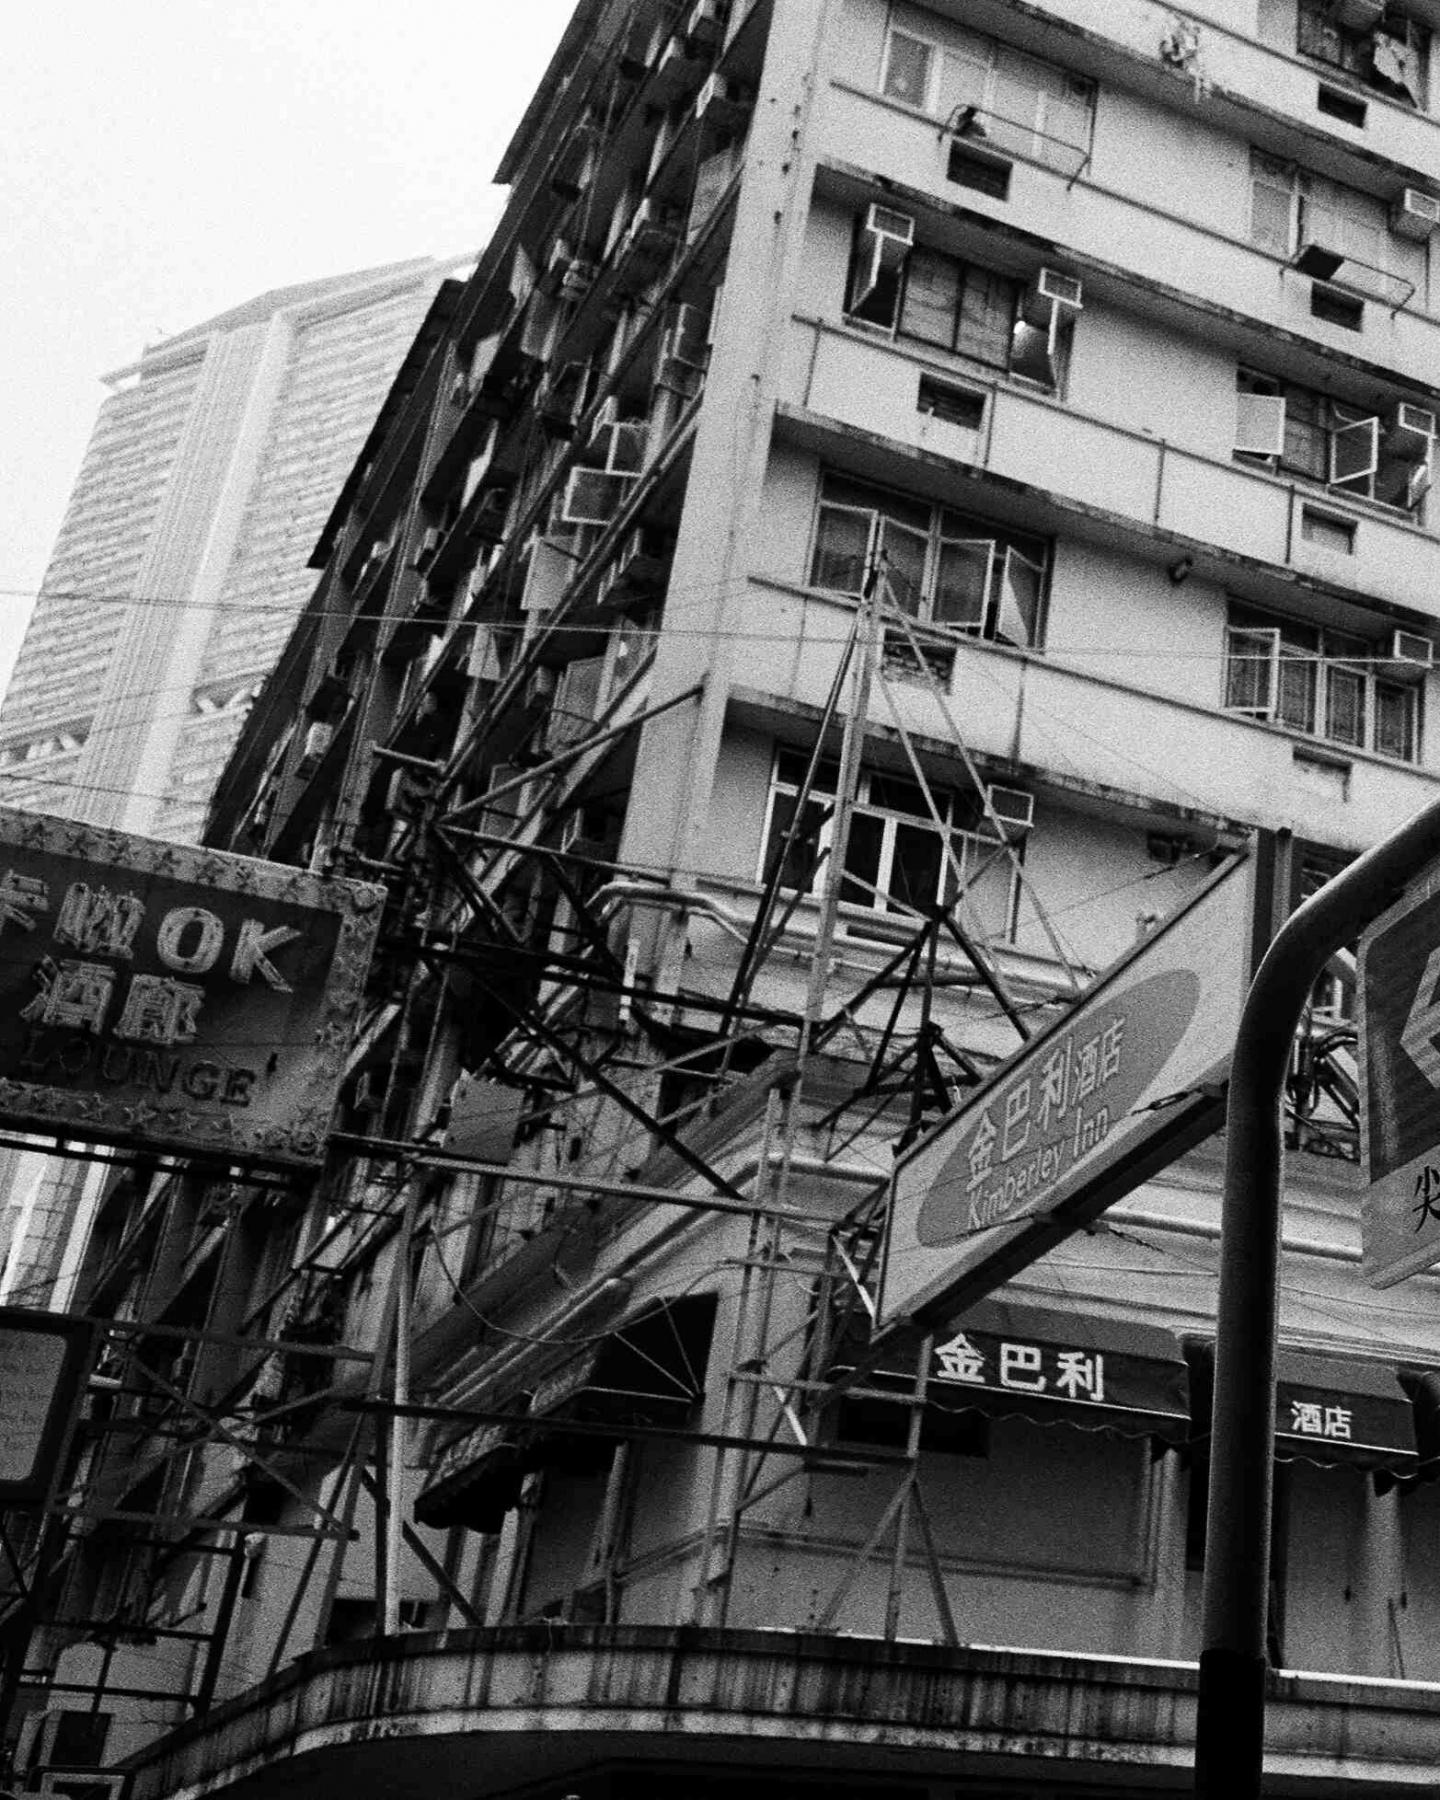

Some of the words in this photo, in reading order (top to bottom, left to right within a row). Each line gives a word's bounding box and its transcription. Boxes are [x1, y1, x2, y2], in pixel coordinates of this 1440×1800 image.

[20, 1030, 255, 1107] LOUNGE
[967, 1142, 1063, 1231] Kimberley
[1074, 1105, 1110, 1158] Inn
[935, 1332, 1104, 1401] 金巴利
[1291, 1400, 1354, 1439] 酒店
